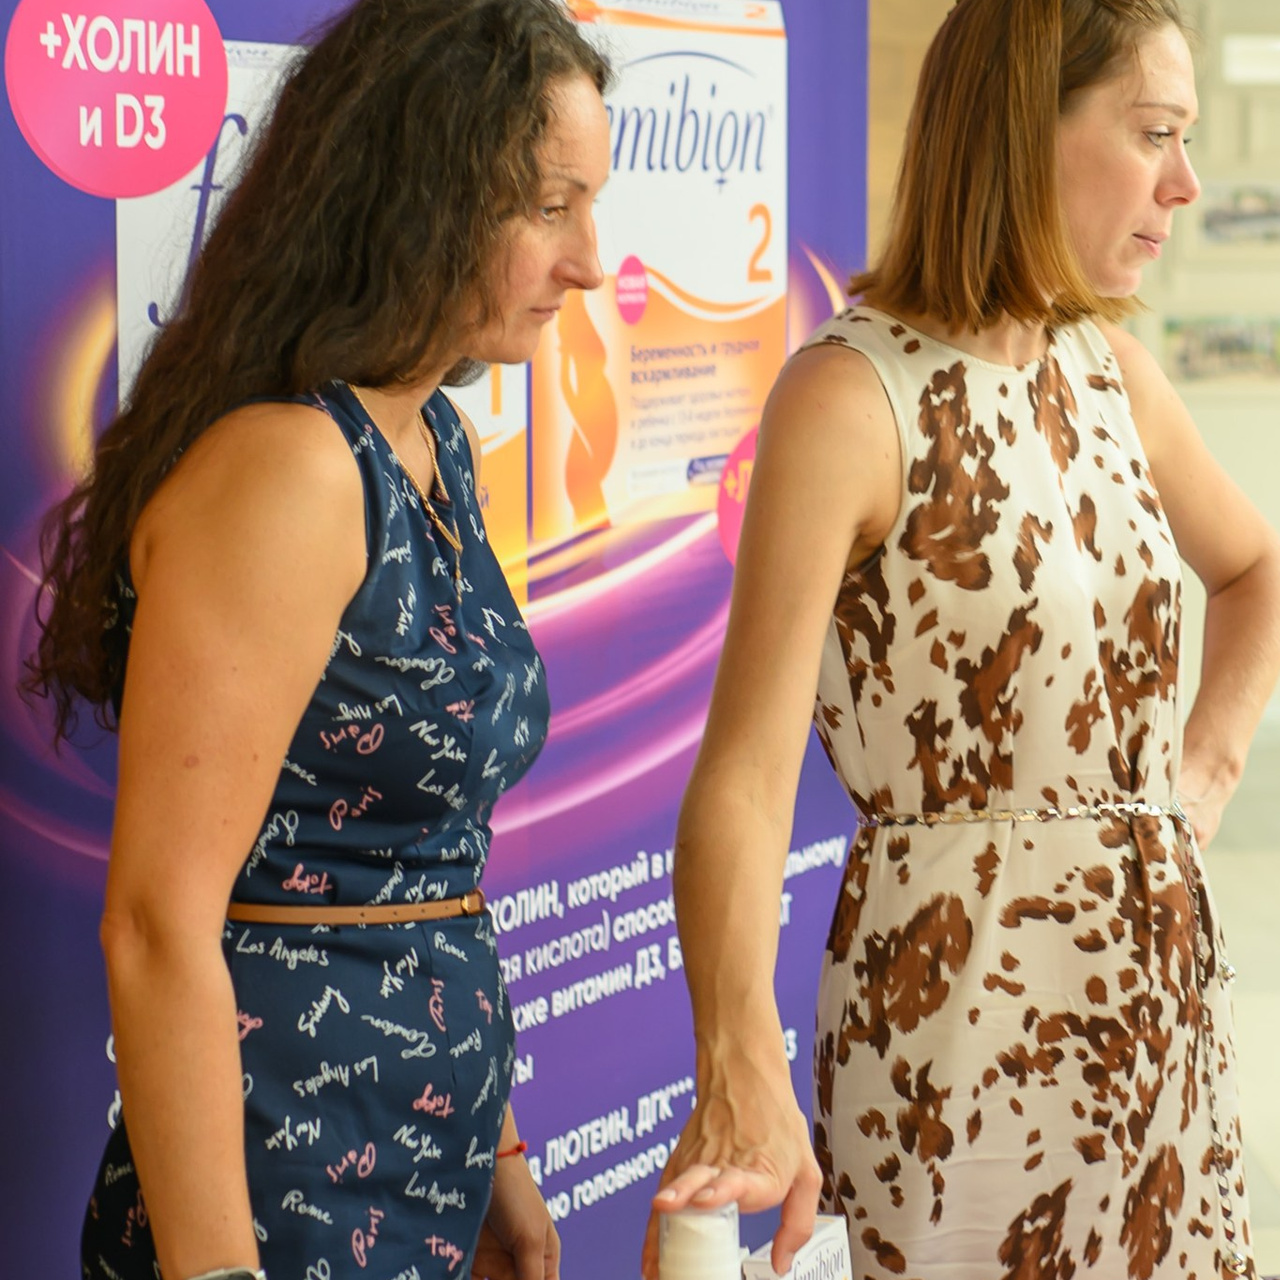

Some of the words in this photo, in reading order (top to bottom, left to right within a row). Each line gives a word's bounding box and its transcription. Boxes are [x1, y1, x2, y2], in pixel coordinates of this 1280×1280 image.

[40, 13, 200, 78] +ХОЛИН
[79, 106, 102, 147] и
[116, 94, 166, 150] D3
[606, 74, 768, 193] mibion
[748, 203, 772, 282] 2
[429, 604, 458, 654] Paris
[374, 656, 456, 691] London
[319, 723, 384, 755] Paris
[329, 785, 384, 831] Paris
[567, 850, 649, 908] который
[235, 928, 265, 954] Los
[268, 937, 329, 970] Angeles
[525, 909, 610, 977] кислота)
[551, 959, 633, 1019] витамин
[360, 1014, 437, 1060] London
[293, 1061, 350, 1098] Angeles
[353, 1055, 379, 1083] Los
[296, 1117, 321, 1146] New
[393, 1124, 420, 1150] New
[543, 1105, 634, 1176] ЛЮТЕИН,
[326, 1141, 376, 1184] Paris
[404, 1170, 428, 1197] Los
[573, 1142, 669, 1212] головного
[281, 1189, 334, 1225] Rome
[351, 1206, 385, 1268] Paris
